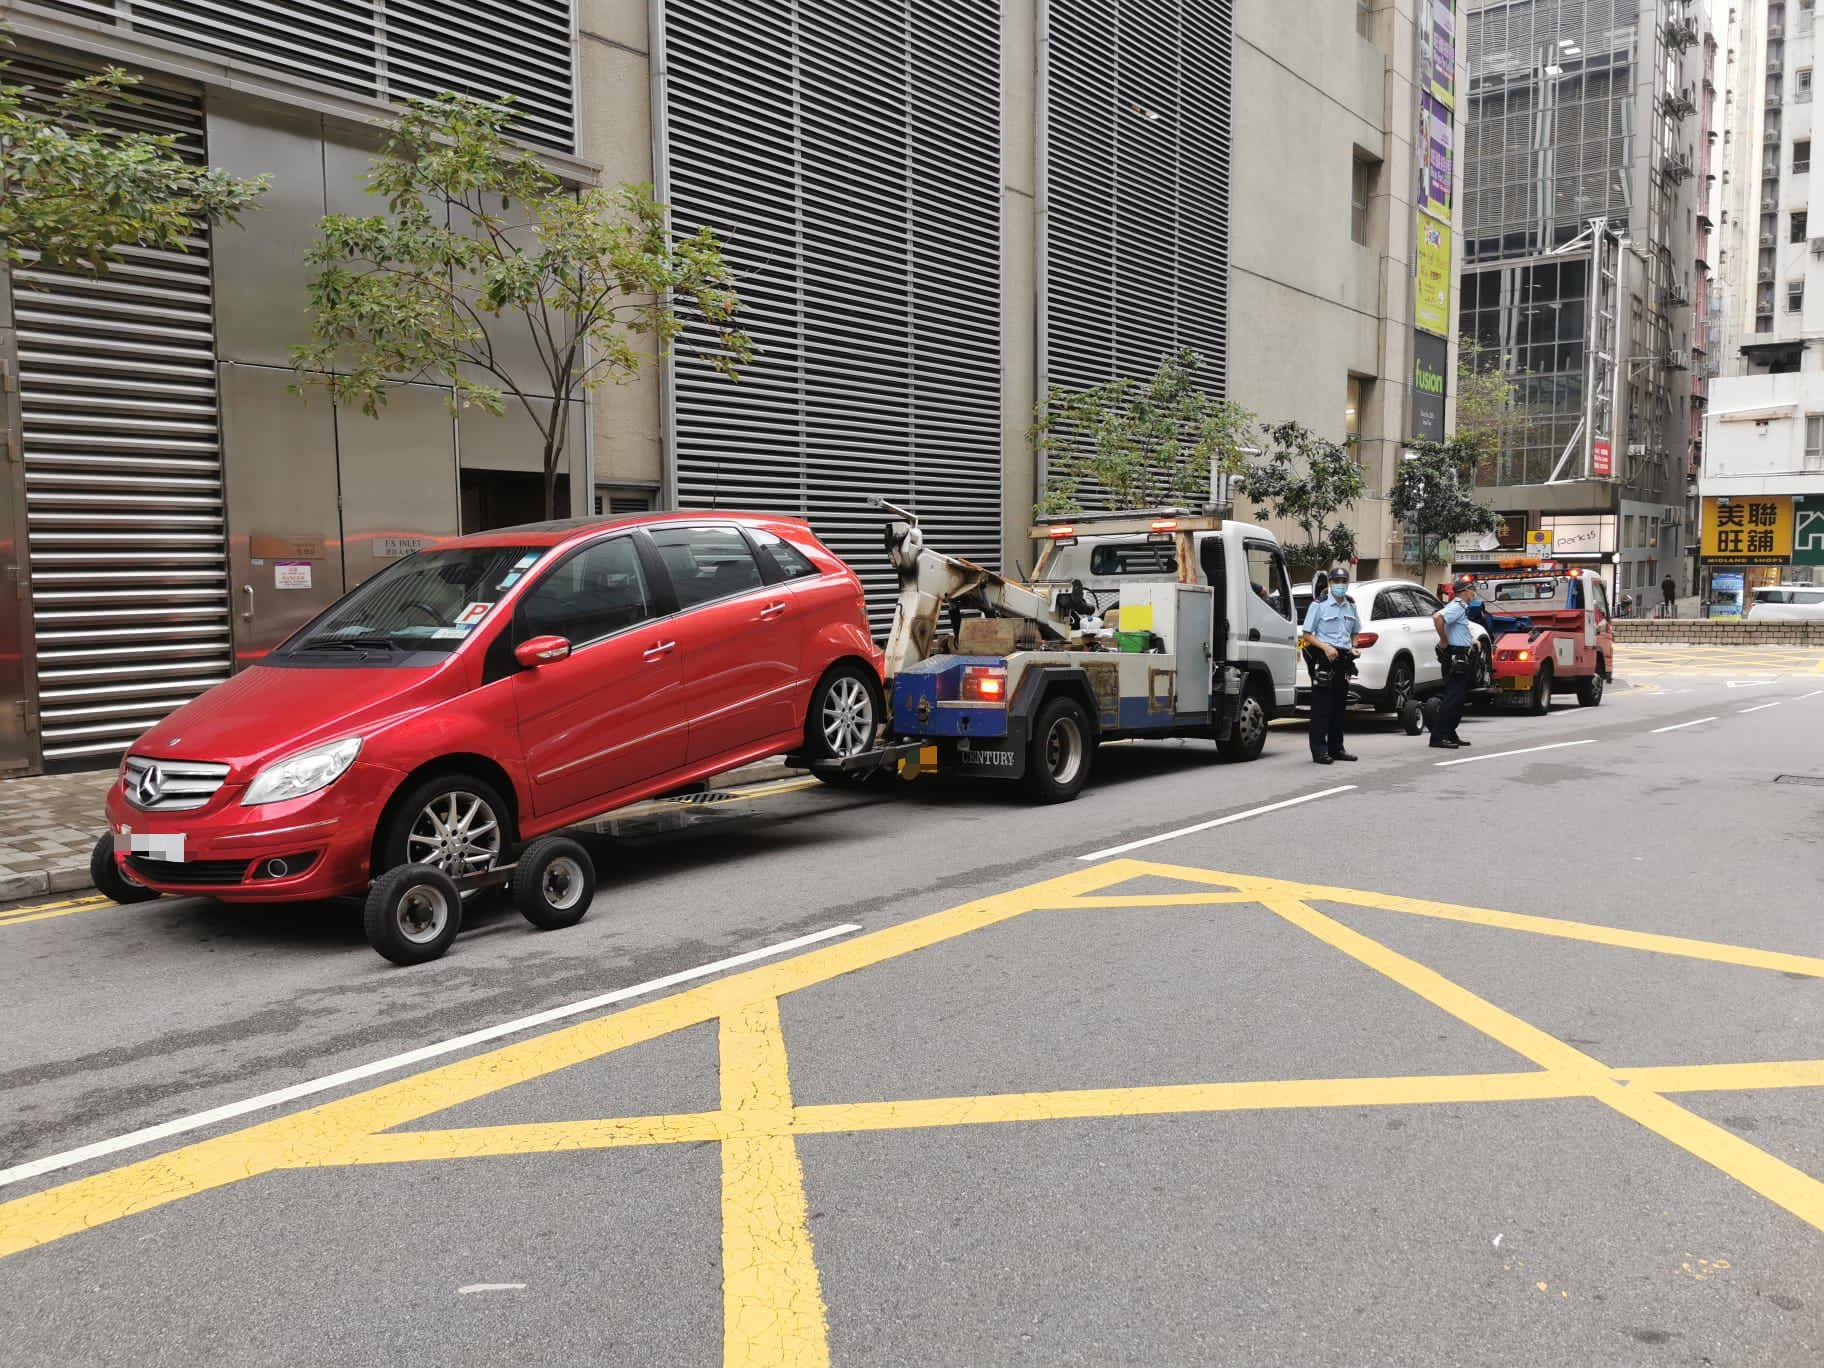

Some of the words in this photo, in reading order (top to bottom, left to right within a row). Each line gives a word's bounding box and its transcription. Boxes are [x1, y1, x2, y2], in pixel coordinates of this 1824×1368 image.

[1415, 358, 1443, 393] fusion
[1717, 504, 1777, 527] 美聯
[463, 604, 489, 622] P
